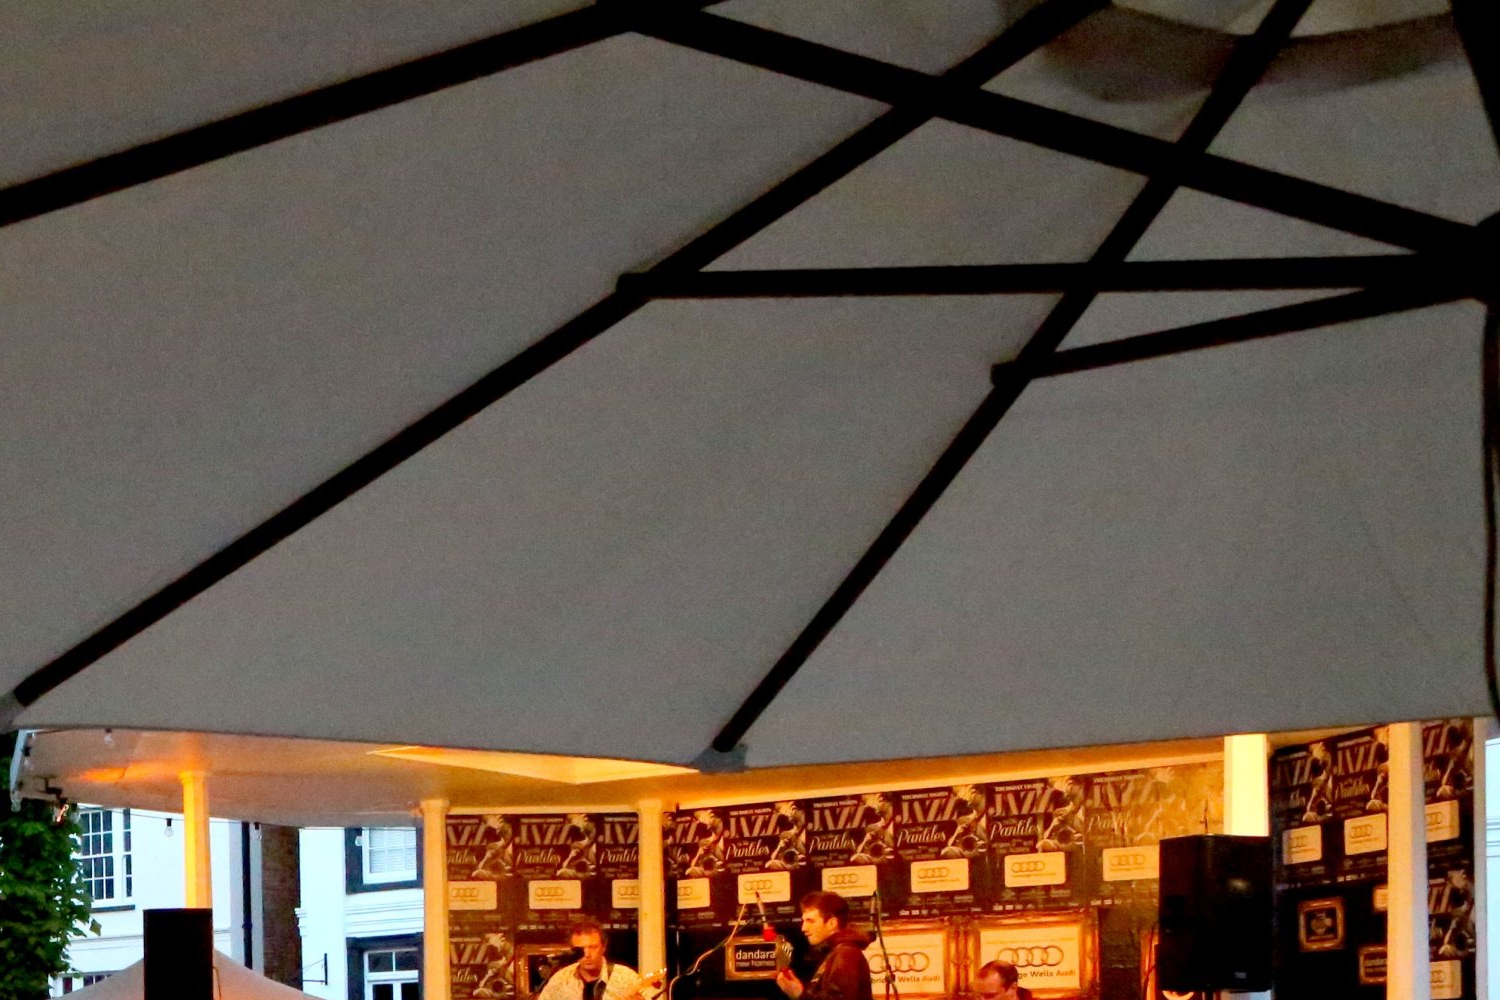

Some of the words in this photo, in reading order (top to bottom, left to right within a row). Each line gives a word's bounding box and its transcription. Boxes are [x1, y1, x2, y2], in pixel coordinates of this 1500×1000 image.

[895, 798, 958, 825] JAZZ
[988, 787, 1054, 817] JAZZ
[723, 813, 780, 838] JAZZ
[807, 805, 867, 832] JAZZ
[446, 823, 489, 846] AZZ
[514, 823, 573, 845] JAZZ
[597, 823, 639, 845] JAZ
[809, 831, 857, 854] Pantiles
[897, 825, 946, 847] Pantiles
[516, 848, 562, 865] Pantiles
[725, 839, 770, 861] Pantiles
[450, 943, 489, 965] AZZ
[735, 950, 776, 960] dandara
